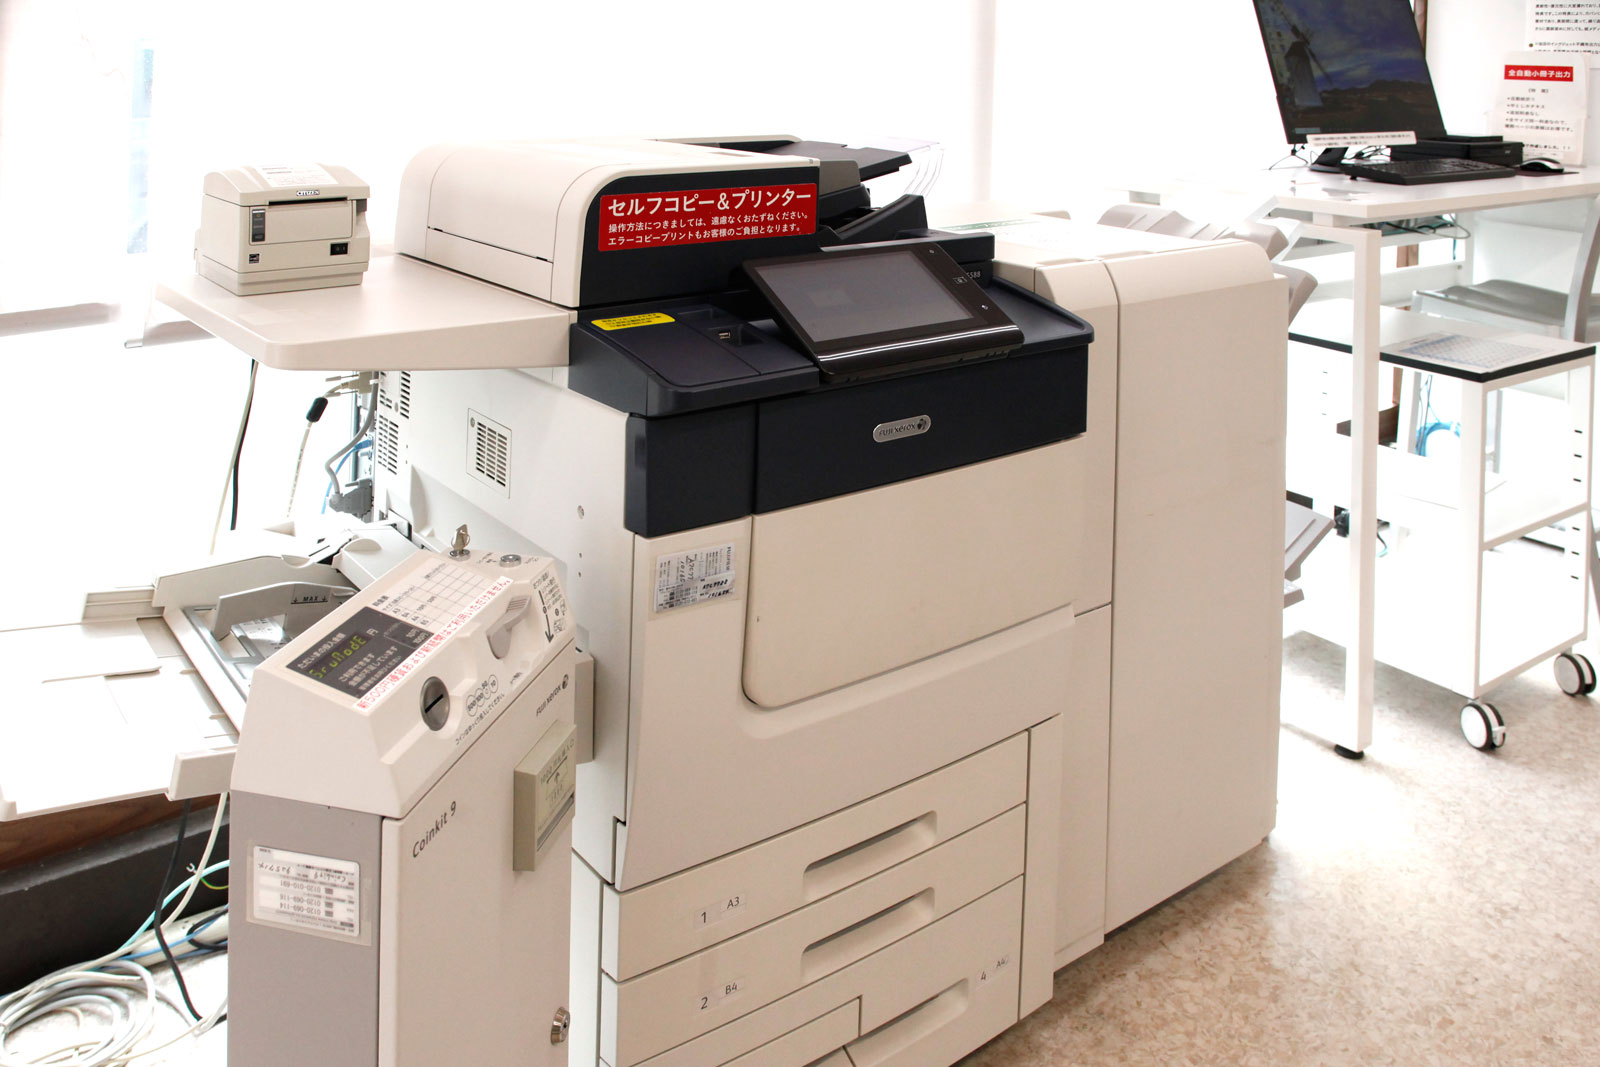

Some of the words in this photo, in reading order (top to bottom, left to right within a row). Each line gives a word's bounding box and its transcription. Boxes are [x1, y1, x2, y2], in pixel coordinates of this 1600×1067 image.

[1508, 69, 1571, 78] 全自動小冊子出力
[607, 188, 811, 217] セルフコピー&プリンター
[608, 211, 808, 233] 操作方法につきましては、遠慮なくおたずねください。
[608, 223, 801, 246] エラーコピープリントもお客様のご負担となります。
[357, 579, 511, 710] 新500円硬貨および新紙幣はご利用いただけません。
[366, 628, 379, 637] 円
[413, 812, 447, 858] Coinkit
[450, 801, 456, 816] 9
[701, 912, 706, 923] 1
[727, 896, 739, 909] A3
[981, 971, 987, 980] 4
[996, 958, 1005, 968] A4
[701, 996, 708, 1009] 2
[726, 982, 737, 994] B4
